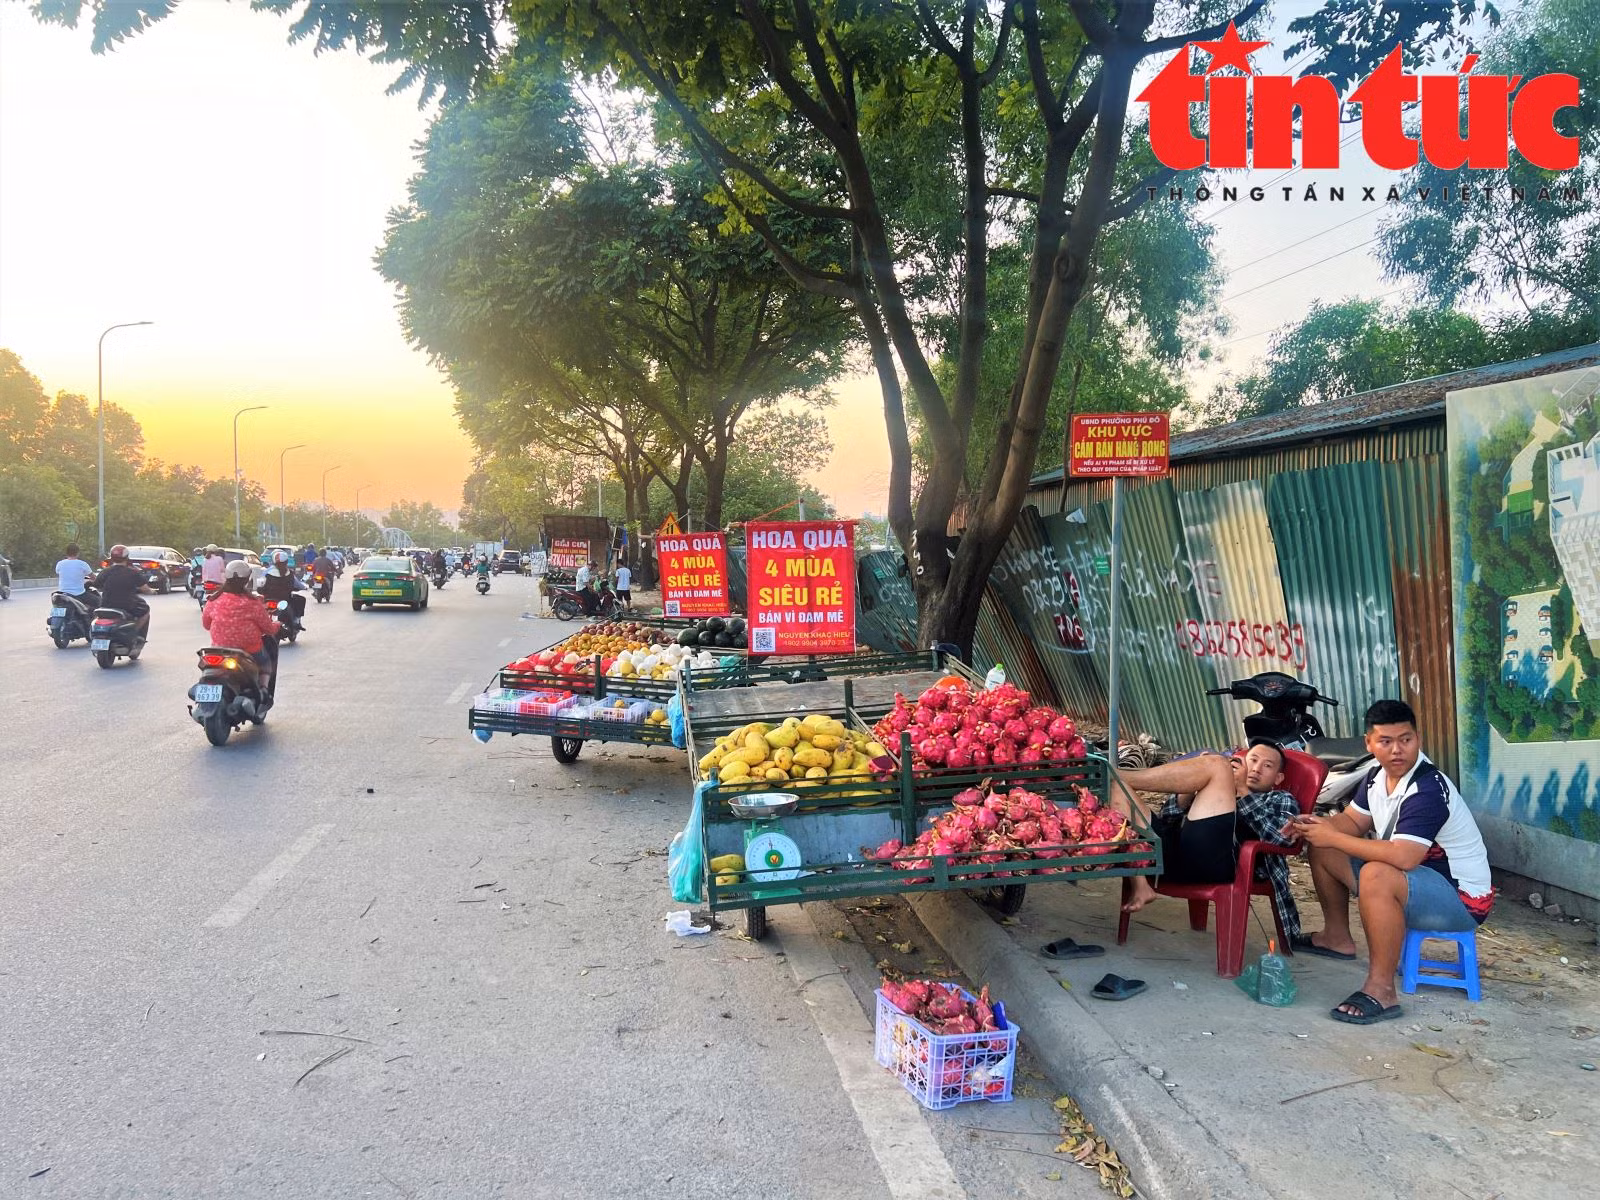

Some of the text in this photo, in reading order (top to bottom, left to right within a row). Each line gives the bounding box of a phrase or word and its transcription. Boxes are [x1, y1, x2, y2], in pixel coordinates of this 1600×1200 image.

[1087, 424, 1152, 439] KHU VỰC
[1074, 437, 1166, 458] CẤM BÁN HÀNG RONG
[660, 533, 722, 552] HOA QUẢ
[752, 523, 848, 550] HOA QUẢ
[670, 554, 716, 569] 4 MÙA
[765, 554, 836, 577] 4 MÙA
[667, 570, 722, 587] SIÊU RẺ
[758, 580, 843, 606] SIÊU RẺ
[758, 610, 782, 624] BÁN
[784, 609, 796, 623] VÌ
[827, 609, 844, 623] MÊ
